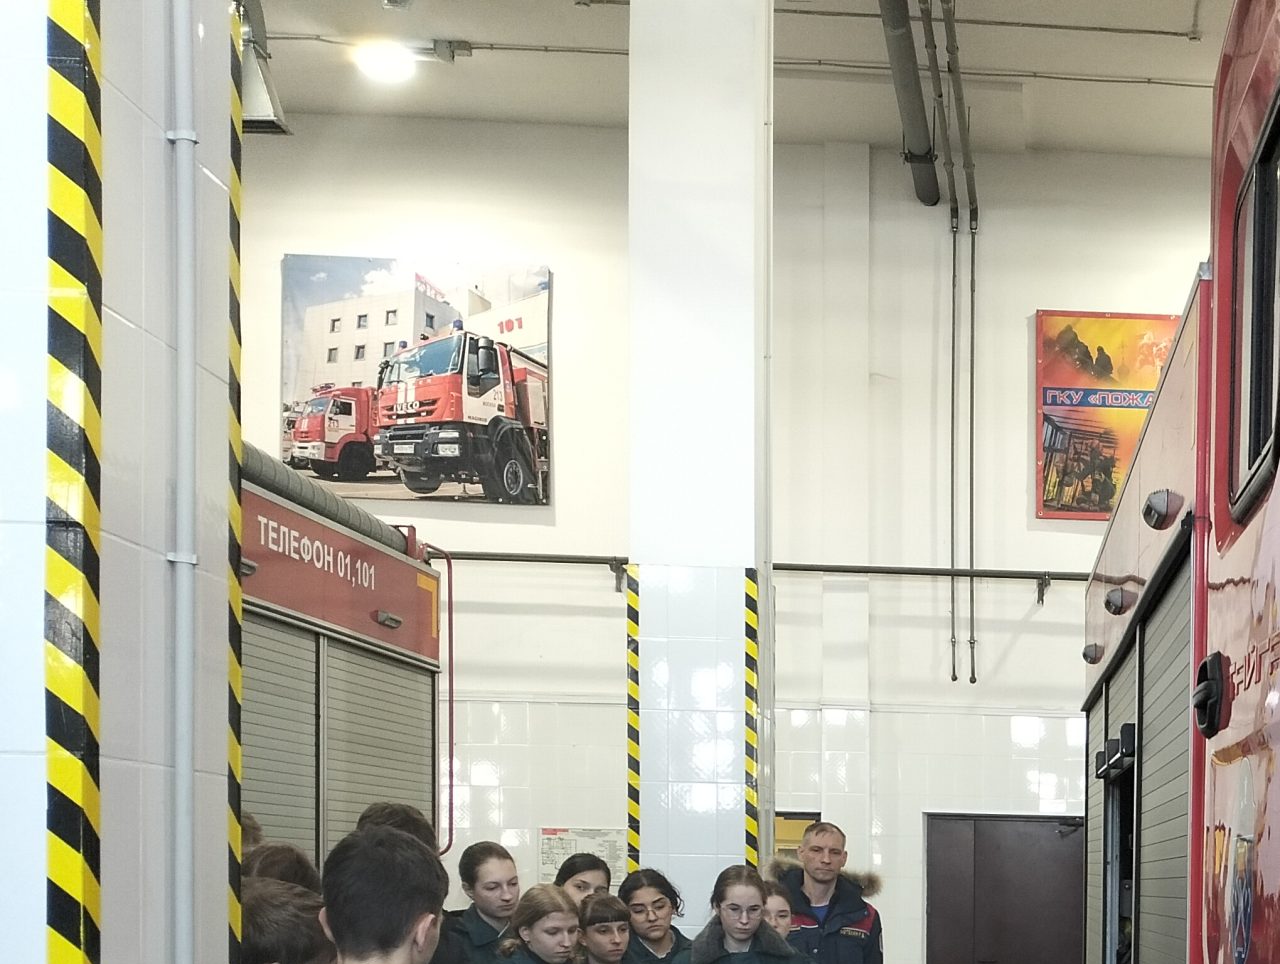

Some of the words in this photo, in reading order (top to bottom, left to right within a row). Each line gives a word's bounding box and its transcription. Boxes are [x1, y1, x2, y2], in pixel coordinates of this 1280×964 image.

[497, 316, 523, 335] 101
[1046, 390, 1084, 405] ГКУ
[393, 401, 420, 412] IVECO
[257, 514, 334, 574] ТЕЛЕФОН
[337, 550, 376, 591] 01,101
